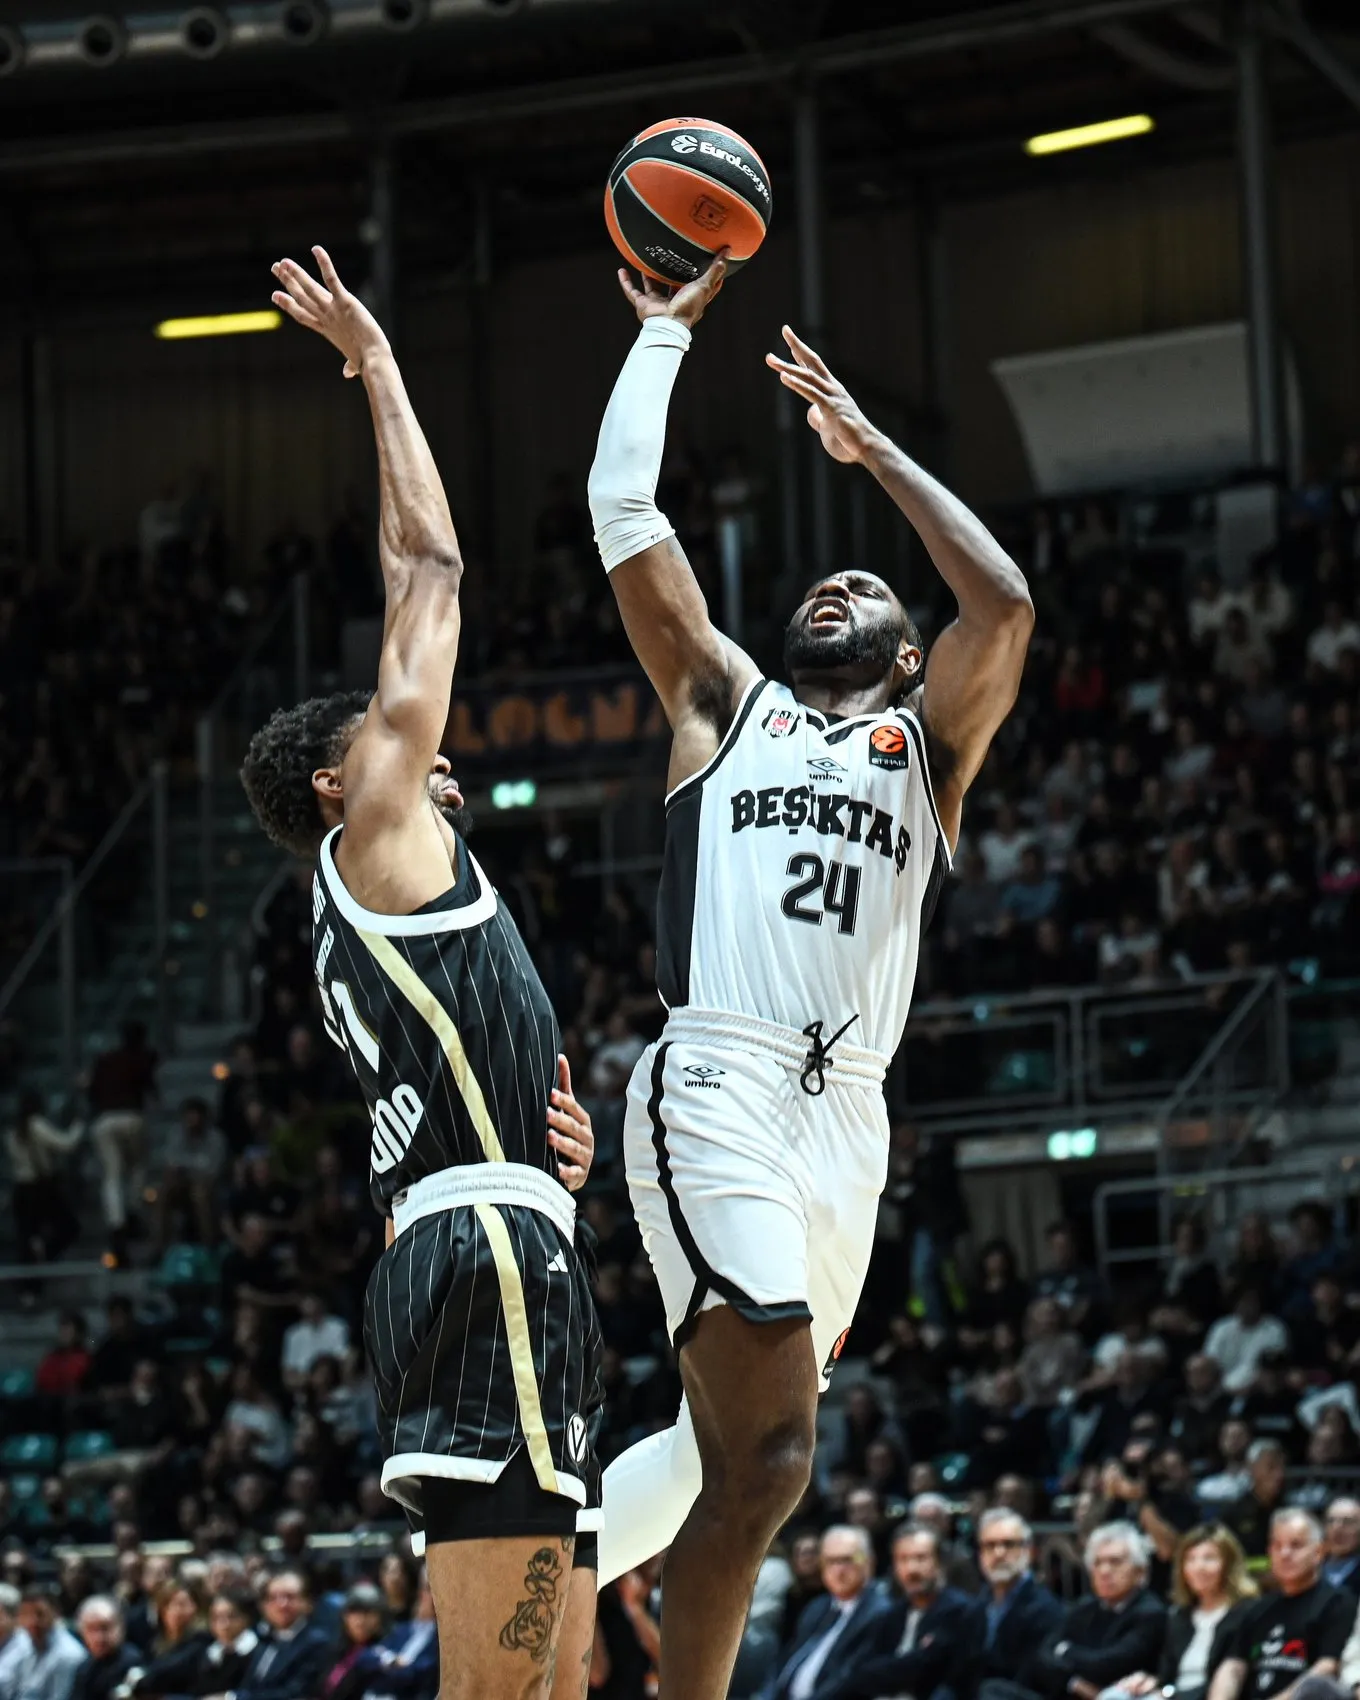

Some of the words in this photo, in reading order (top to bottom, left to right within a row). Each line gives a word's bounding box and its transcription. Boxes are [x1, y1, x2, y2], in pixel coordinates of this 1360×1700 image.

[809, 772, 843, 784] umbro
[731, 785, 911, 877] BEŞİKTAŞ
[780, 852, 863, 936] 24
[684, 1078, 721, 1090] umbro
